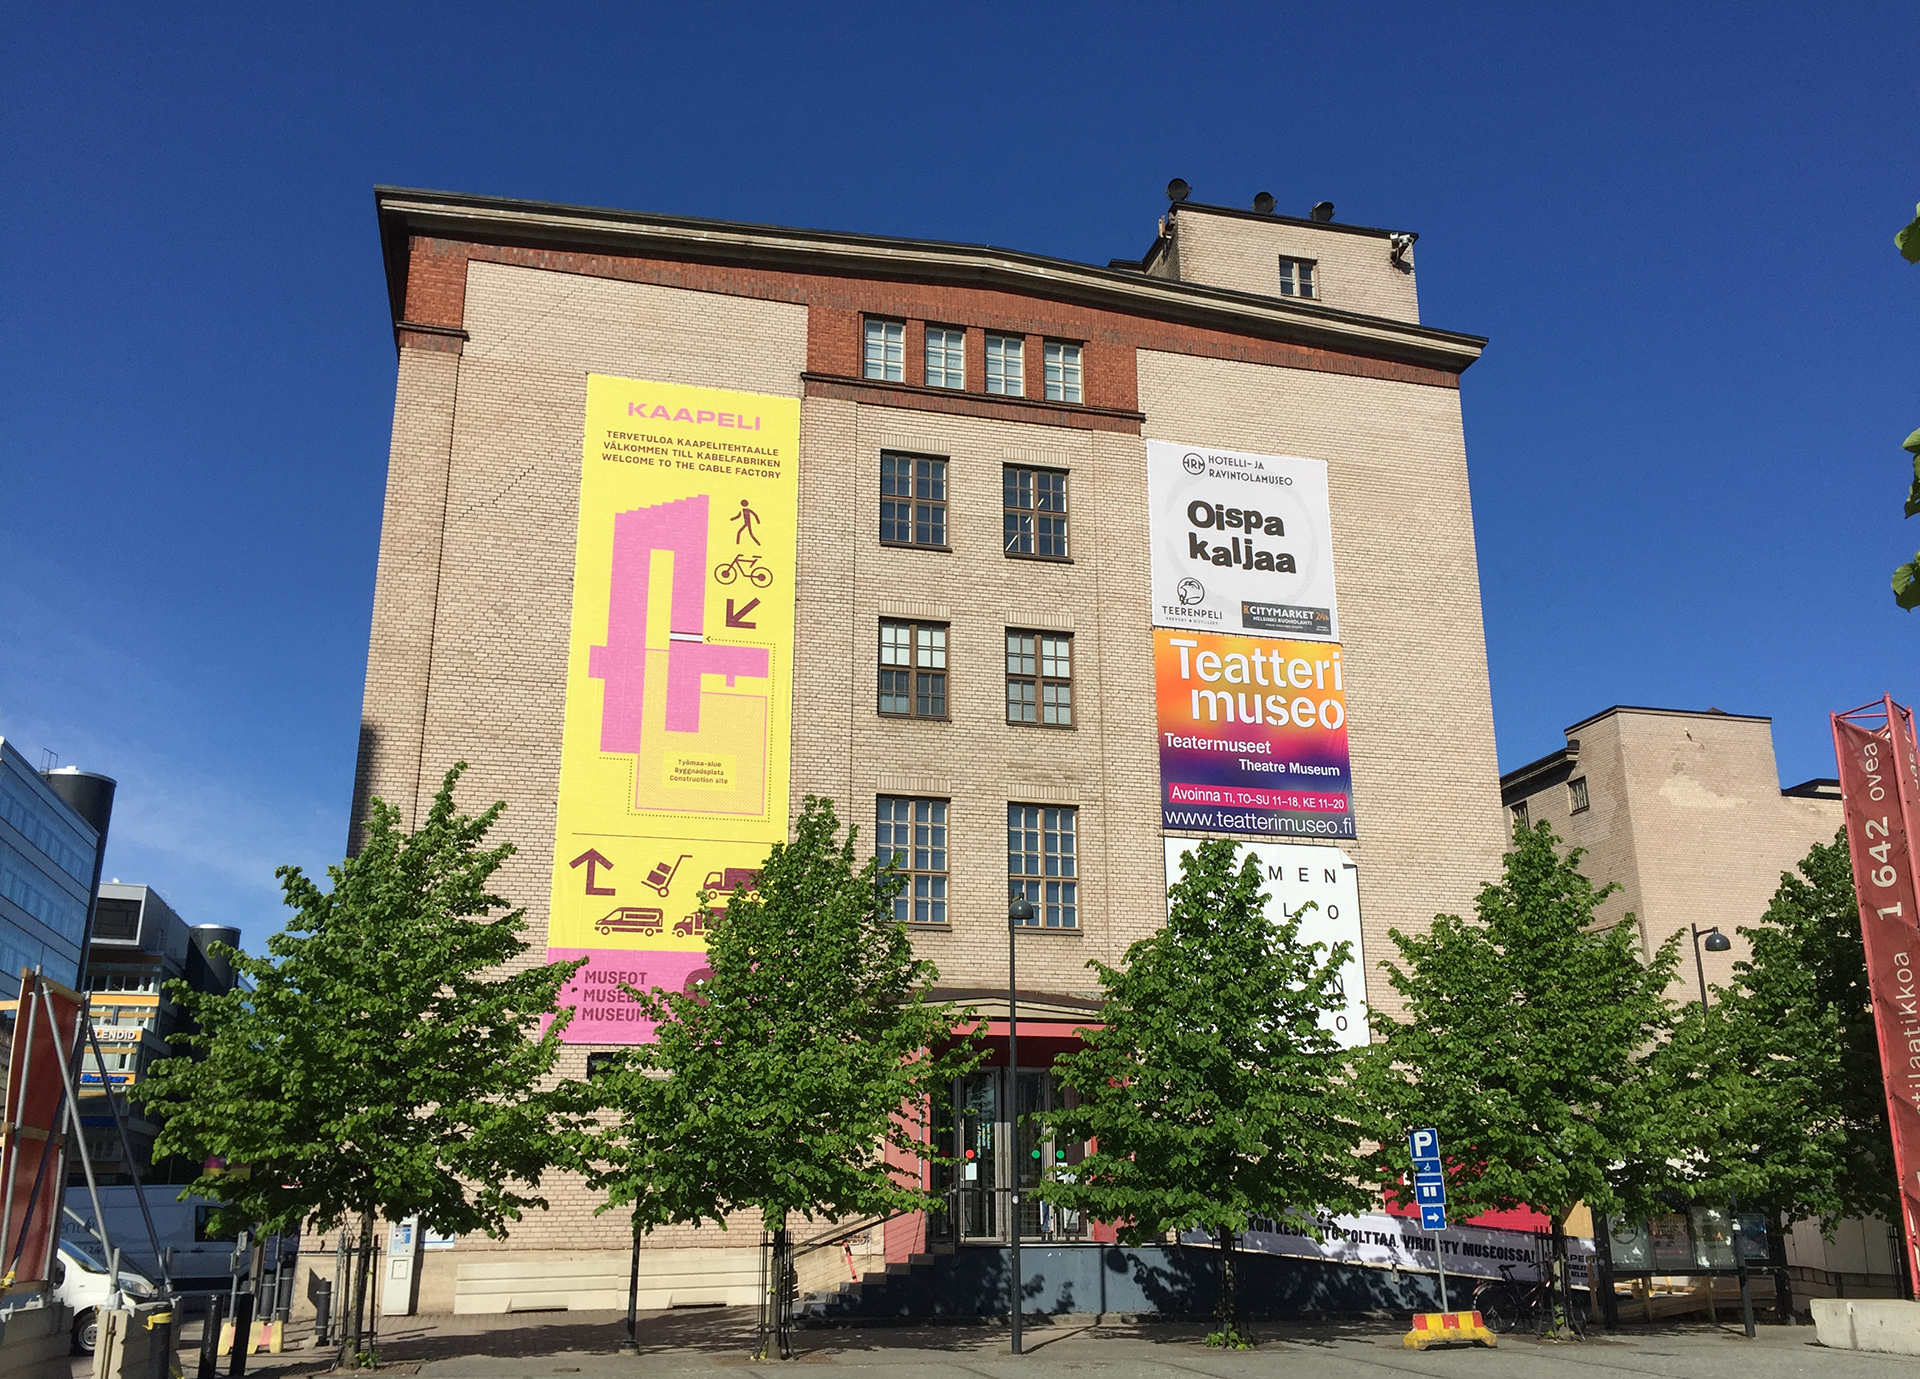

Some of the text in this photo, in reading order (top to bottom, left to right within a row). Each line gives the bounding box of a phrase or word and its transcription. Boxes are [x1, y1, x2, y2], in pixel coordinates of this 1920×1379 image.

[628, 402, 760, 430] KAAPELI
[603, 441, 781, 468] VÄLKOMMEN TILL KABELFABRIKEN
[606, 430, 779, 456] TERVETULOA KAAPELITEHTAALLE
[602, 453, 781, 479] WELCOME TO THE CABLE FACTORY
[1208, 455, 1265, 470] HOTELLI- JA
[1209, 468, 1293, 487] RAVINTOLAMUSEO
[1187, 500, 1285, 537] Oispa
[1188, 532, 1297, 574] kaljaa
[1162, 605, 1223, 620] TEERENPELI
[1250, 605, 1315, 620] CITYMARKET
[1169, 638, 1343, 691] Teatteri
[1191, 689, 1345, 730] museo
[1164, 732, 1272, 755] Teatermuseet
[674, 766, 725, 776] Byggnadsplats
[678, 758, 722, 768] Työmaa-alue
[1238, 758, 1341, 777] Theatre Museum
[1864, 742, 1885, 802] ovea
[669, 774, 714, 783] Construction
[1171, 785, 1221, 802] Avoinna
[1223, 792, 1236, 805] TI,
[1303, 797, 1317, 808] KE
[1165, 810, 1353, 835] www.teatterimuseo.fi
[1865, 816, 1897, 889] 642
[1268, 865, 1336, 884] MEN
[584, 970, 648, 985] MUSEOT
[583, 988, 648, 1004] MUSEE
[1414, 1131, 1432, 1157] P
[1344, 1228, 1400, 1249] POLTTAA,
[1462, 1242, 1535, 1264] MUSEOISSA!
